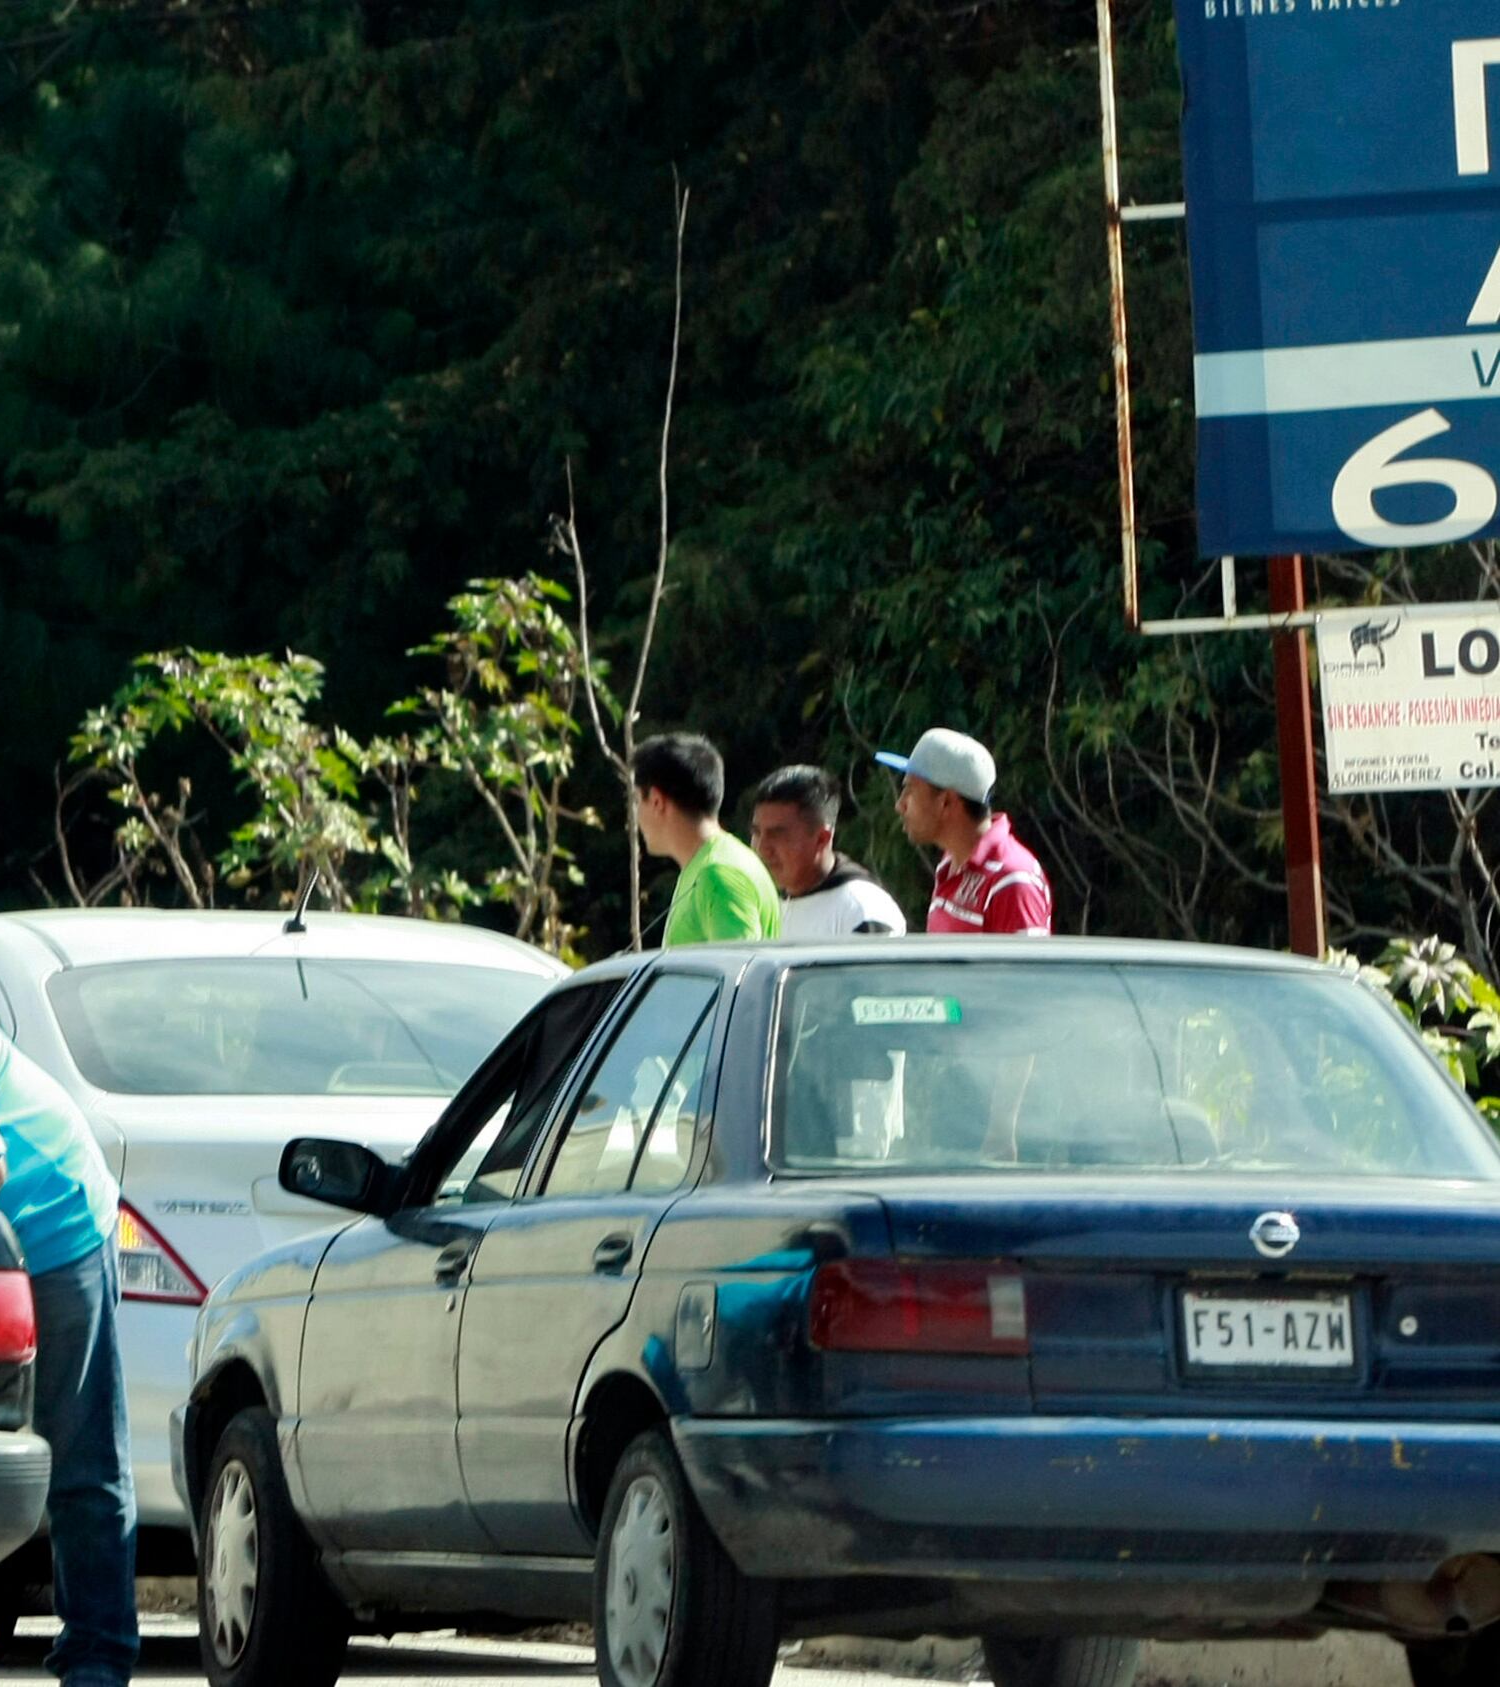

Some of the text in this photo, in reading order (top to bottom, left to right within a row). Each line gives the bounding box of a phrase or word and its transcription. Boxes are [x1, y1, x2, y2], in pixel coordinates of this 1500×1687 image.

[1332, 407, 1497, 547] 6
[1421, 629, 1500, 678] LO
[1327, 703, 1344, 731] SIN
[1347, 701, 1400, 729] ENGANCHE
[1403, 766, 1442, 783] PEREZ
[1193, 1310, 1346, 1350] F51-AZW
